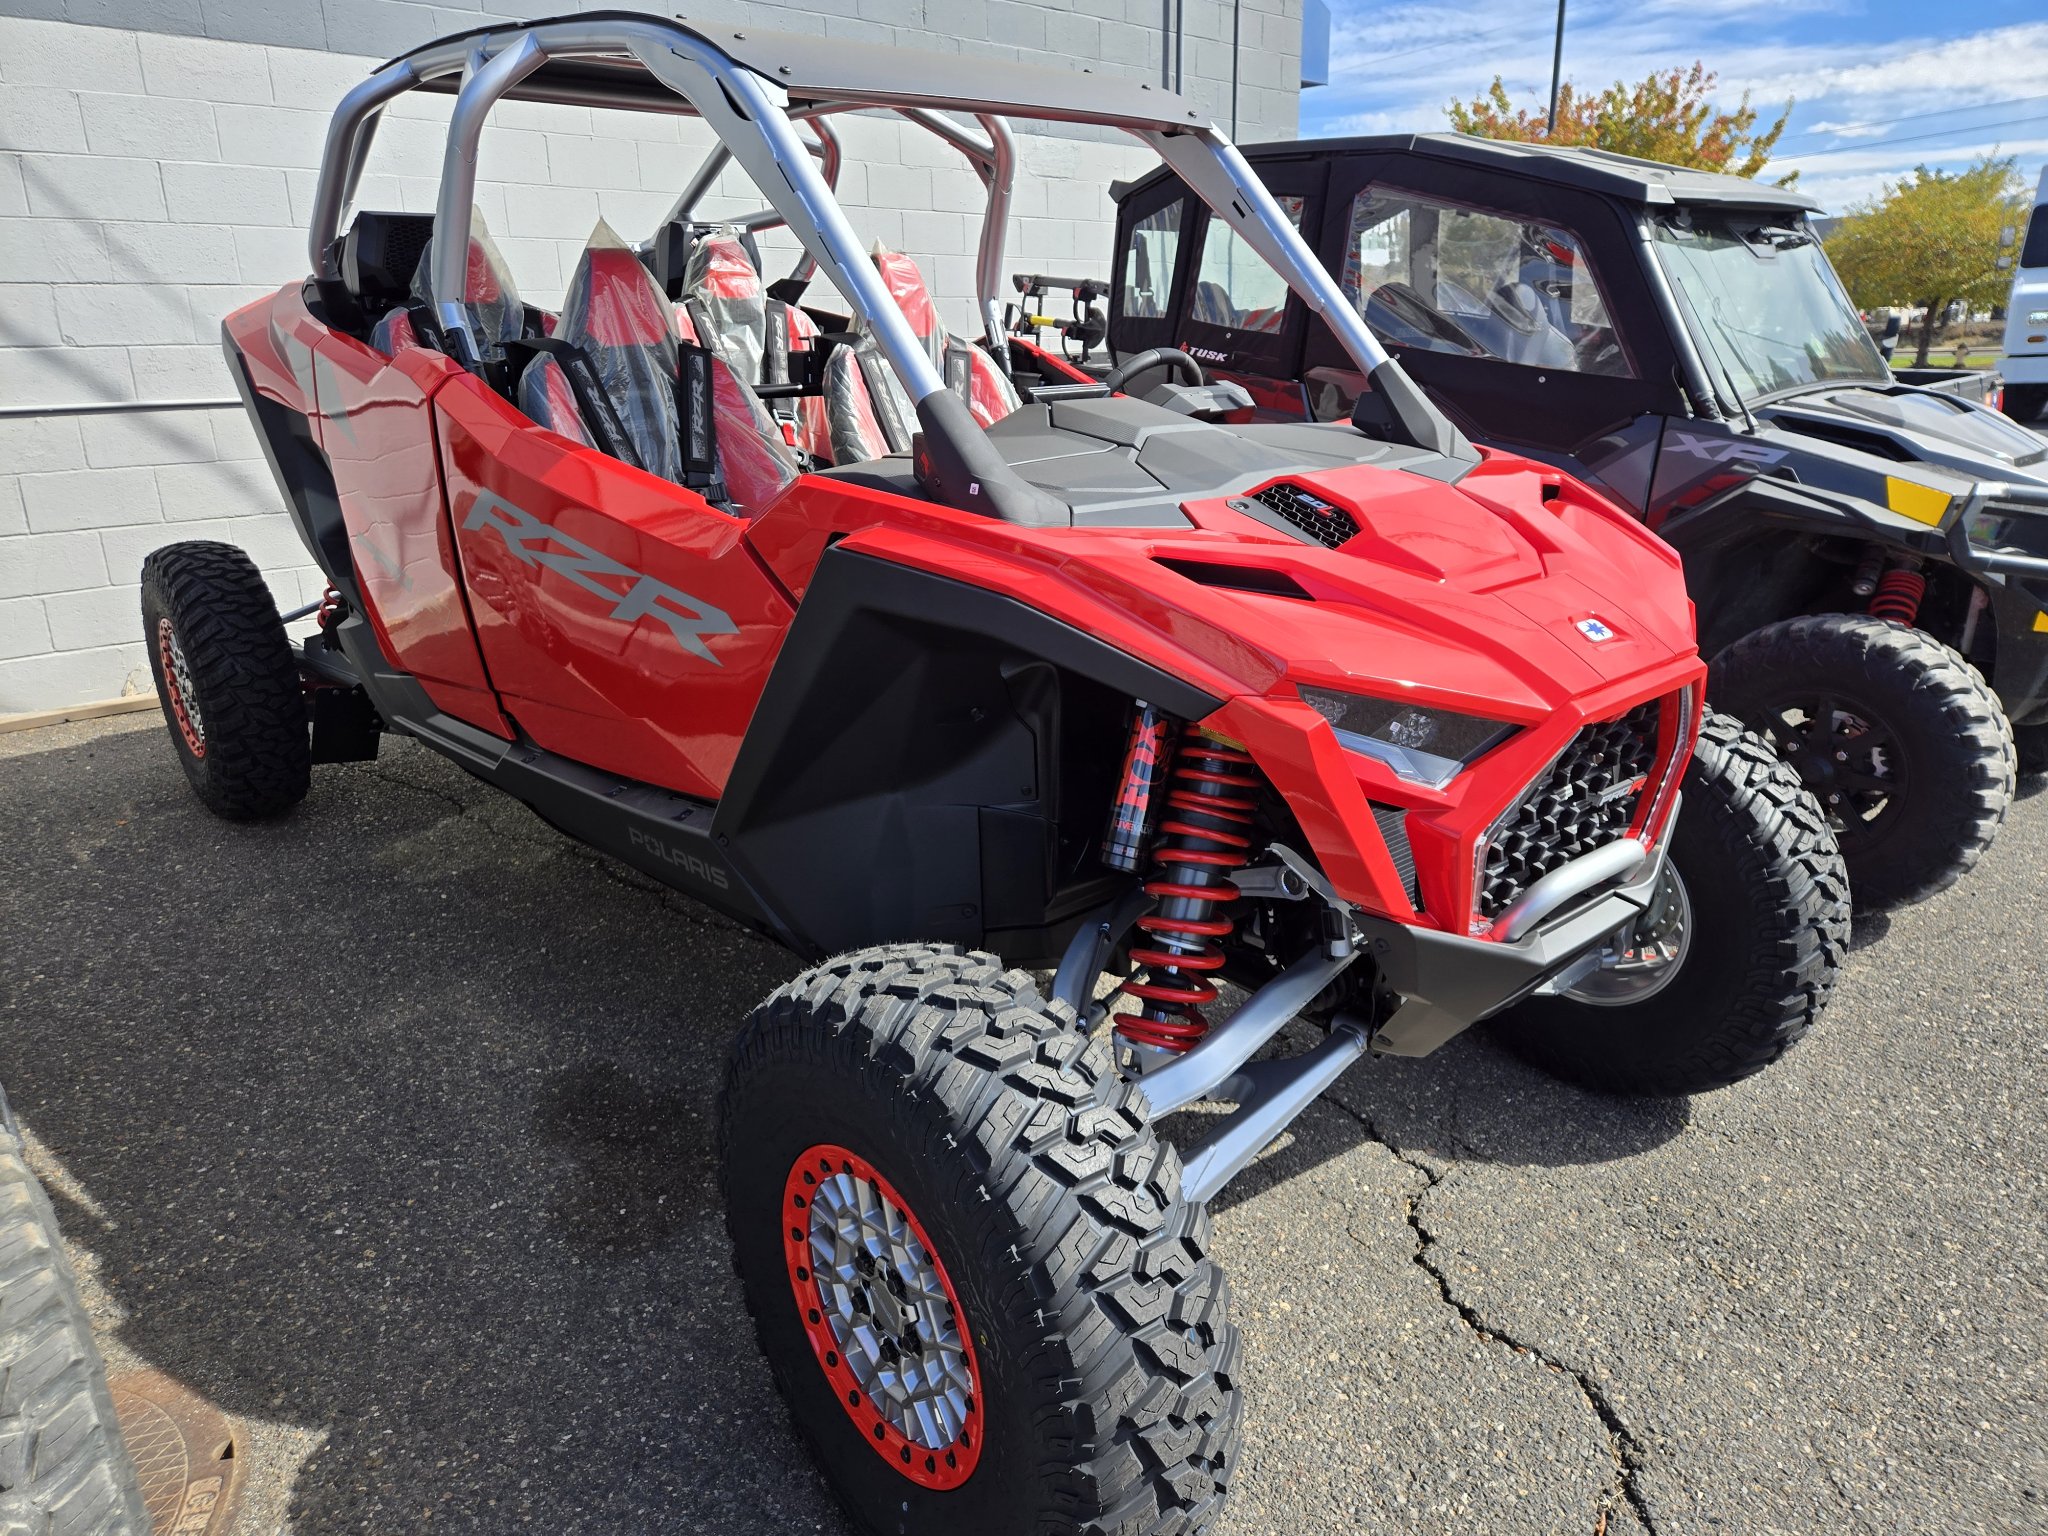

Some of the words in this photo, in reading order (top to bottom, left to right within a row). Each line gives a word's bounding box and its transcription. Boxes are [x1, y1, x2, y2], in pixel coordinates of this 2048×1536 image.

[1189, 346, 1228, 362] TUSK
[587, 386, 623, 441] RZR
[691, 379, 705, 435] RZR
[1662, 432, 1790, 464] XP
[462, 487, 741, 668] RZR
[1115, 715, 1168, 812] FOX
[628, 826, 729, 890] POLARIS
